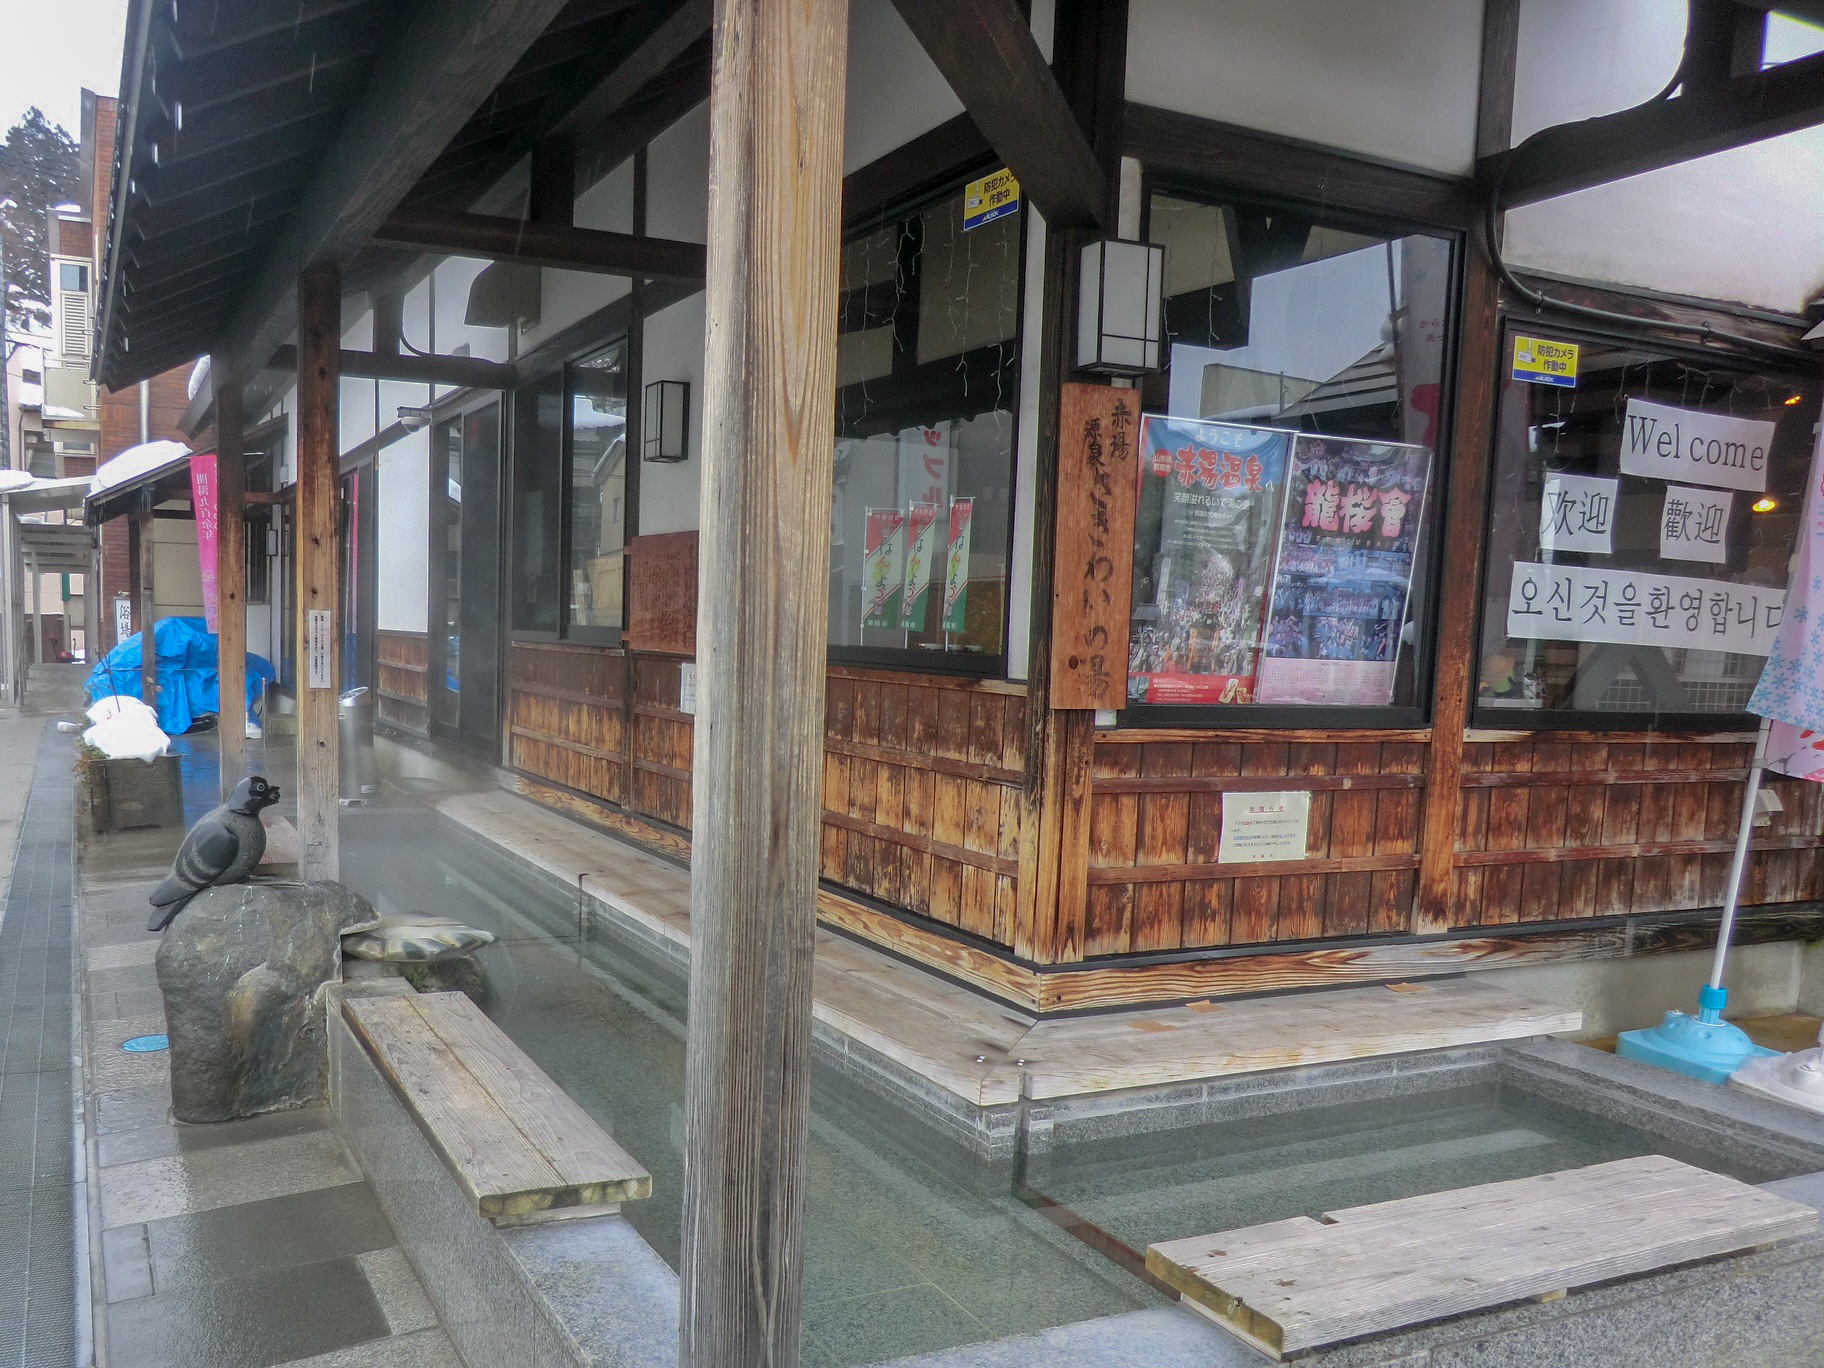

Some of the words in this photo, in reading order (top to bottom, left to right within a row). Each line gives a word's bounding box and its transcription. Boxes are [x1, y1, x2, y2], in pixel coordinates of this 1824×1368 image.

[989, 187, 1011, 207] 作動中
[1537, 344, 1574, 360] 防犯カメラ
[1543, 359, 1567, 373] 作動中
[1111, 397, 1133, 462] 赤湯
[1195, 427, 1244, 448] ようこそ
[1174, 442, 1264, 493] 赤湯温泉
[1541, 490, 1610, 536] 欢迎
[1663, 498, 1724, 544] 歡迎
[119, 604, 131, 642] 浴場
